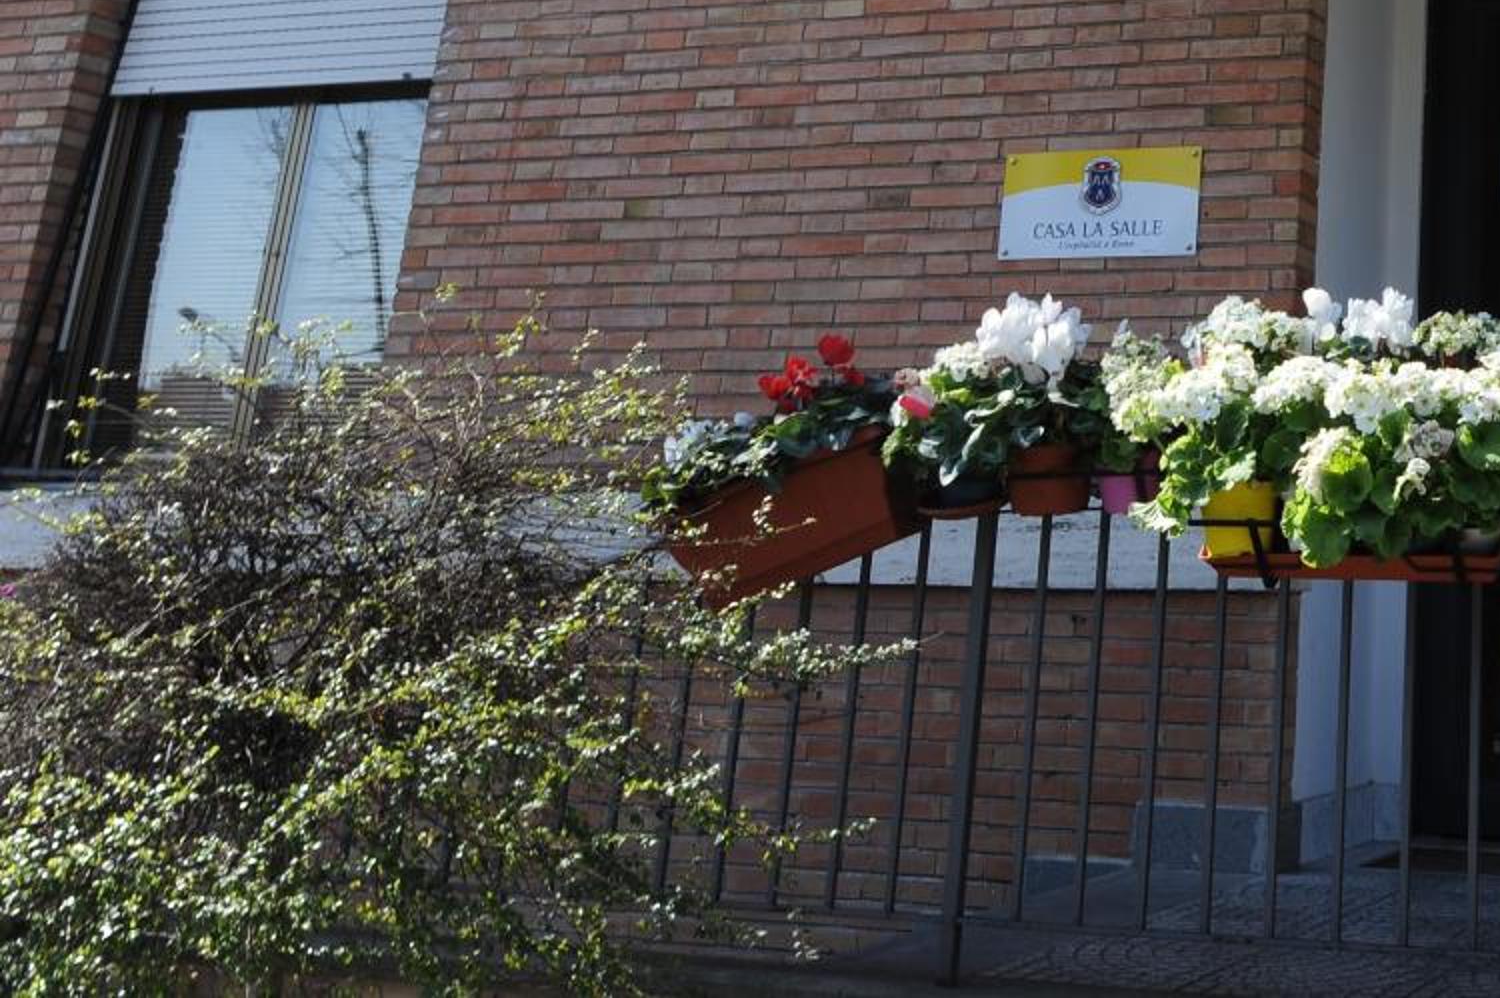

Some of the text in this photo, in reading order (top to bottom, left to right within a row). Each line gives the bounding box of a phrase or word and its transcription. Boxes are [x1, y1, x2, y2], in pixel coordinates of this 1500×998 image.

[1033, 218, 1164, 240] CASA LA SALLE
